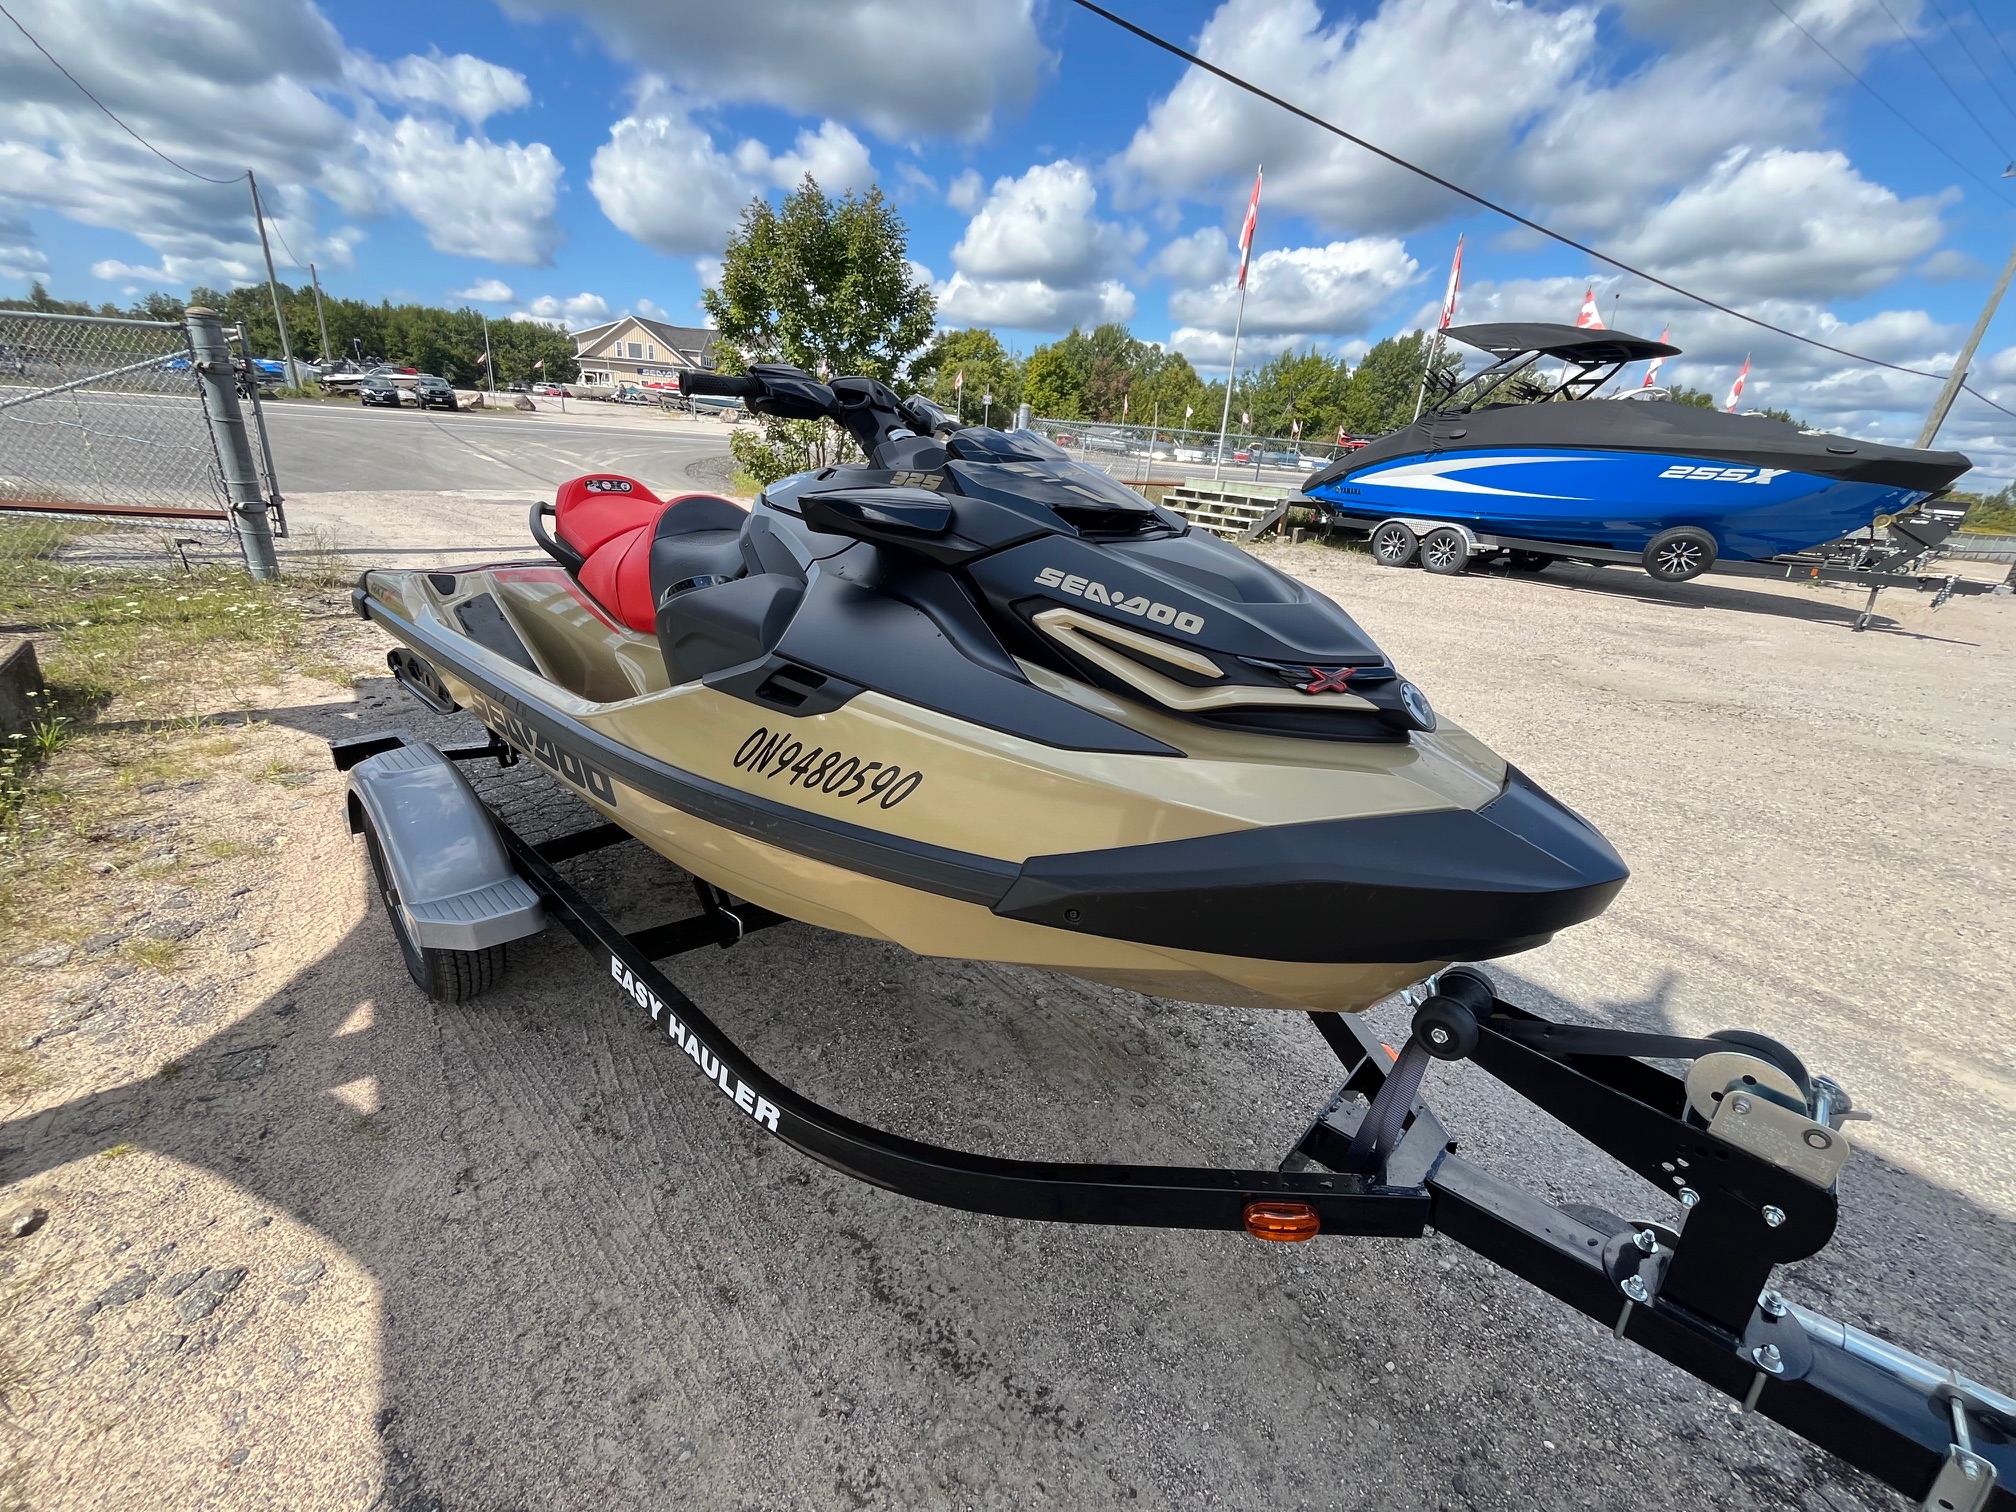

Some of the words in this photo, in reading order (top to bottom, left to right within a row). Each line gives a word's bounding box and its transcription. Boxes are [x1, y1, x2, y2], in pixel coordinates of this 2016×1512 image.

[890, 471, 944, 491] 325
[1658, 466, 1791, 485] 255X
[733, 726, 924, 810] ON9480590
[611, 954, 663, 1021] EASY
[668, 1013, 781, 1133] HAULER
